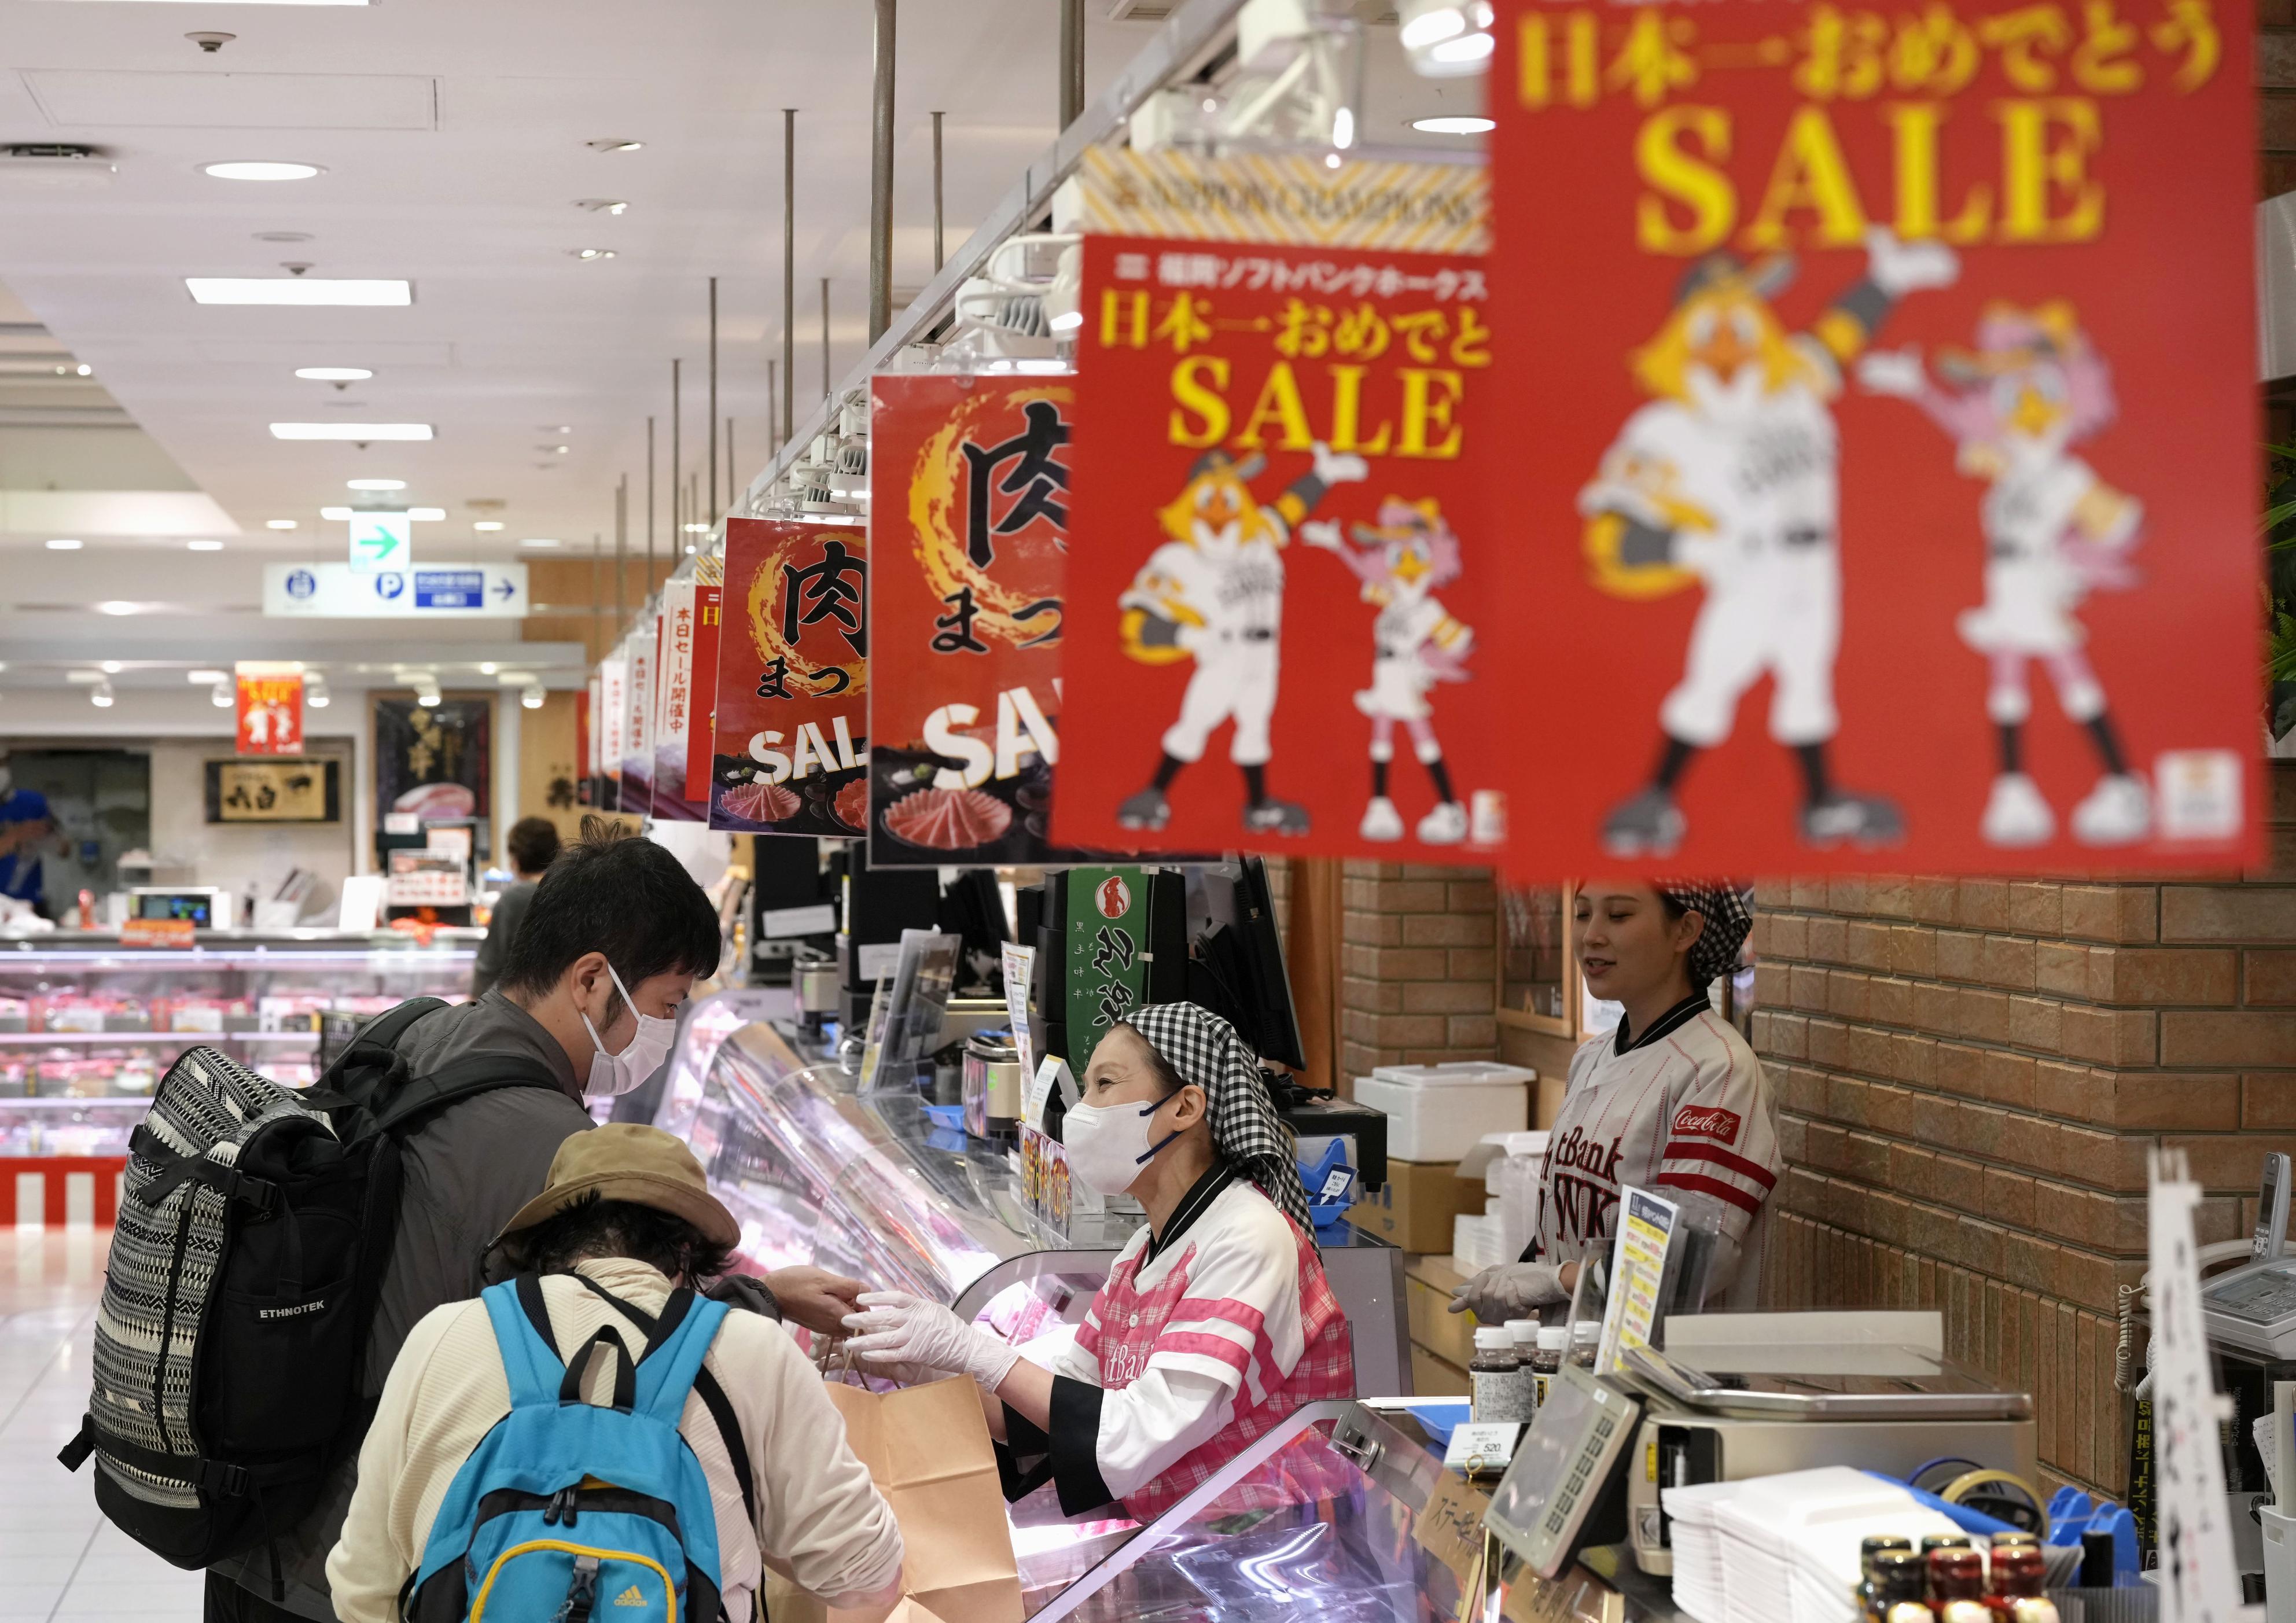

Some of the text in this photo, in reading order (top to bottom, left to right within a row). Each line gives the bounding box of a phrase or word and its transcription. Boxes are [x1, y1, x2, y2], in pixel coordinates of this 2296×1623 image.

[1517, 0, 2221, 109] 日本一おめでとう
[1633, 100, 2106, 255] SALE
[1168, 354, 1465, 459] SALE
[961, 399, 1073, 570] 肉
[782, 540, 867, 658] 肉
[668, 606, 692, 735] 本日セール開催中
[756, 655, 850, 700] まつ
[923, 678, 1064, 792] SA
[1675, 1109, 1736, 1137] Coca-Cola
[259, 1300, 325, 1319] ETHNOTEK
[1483, 1443, 1502, 1452] 520
[613, 1598, 647, 1607] adidas
